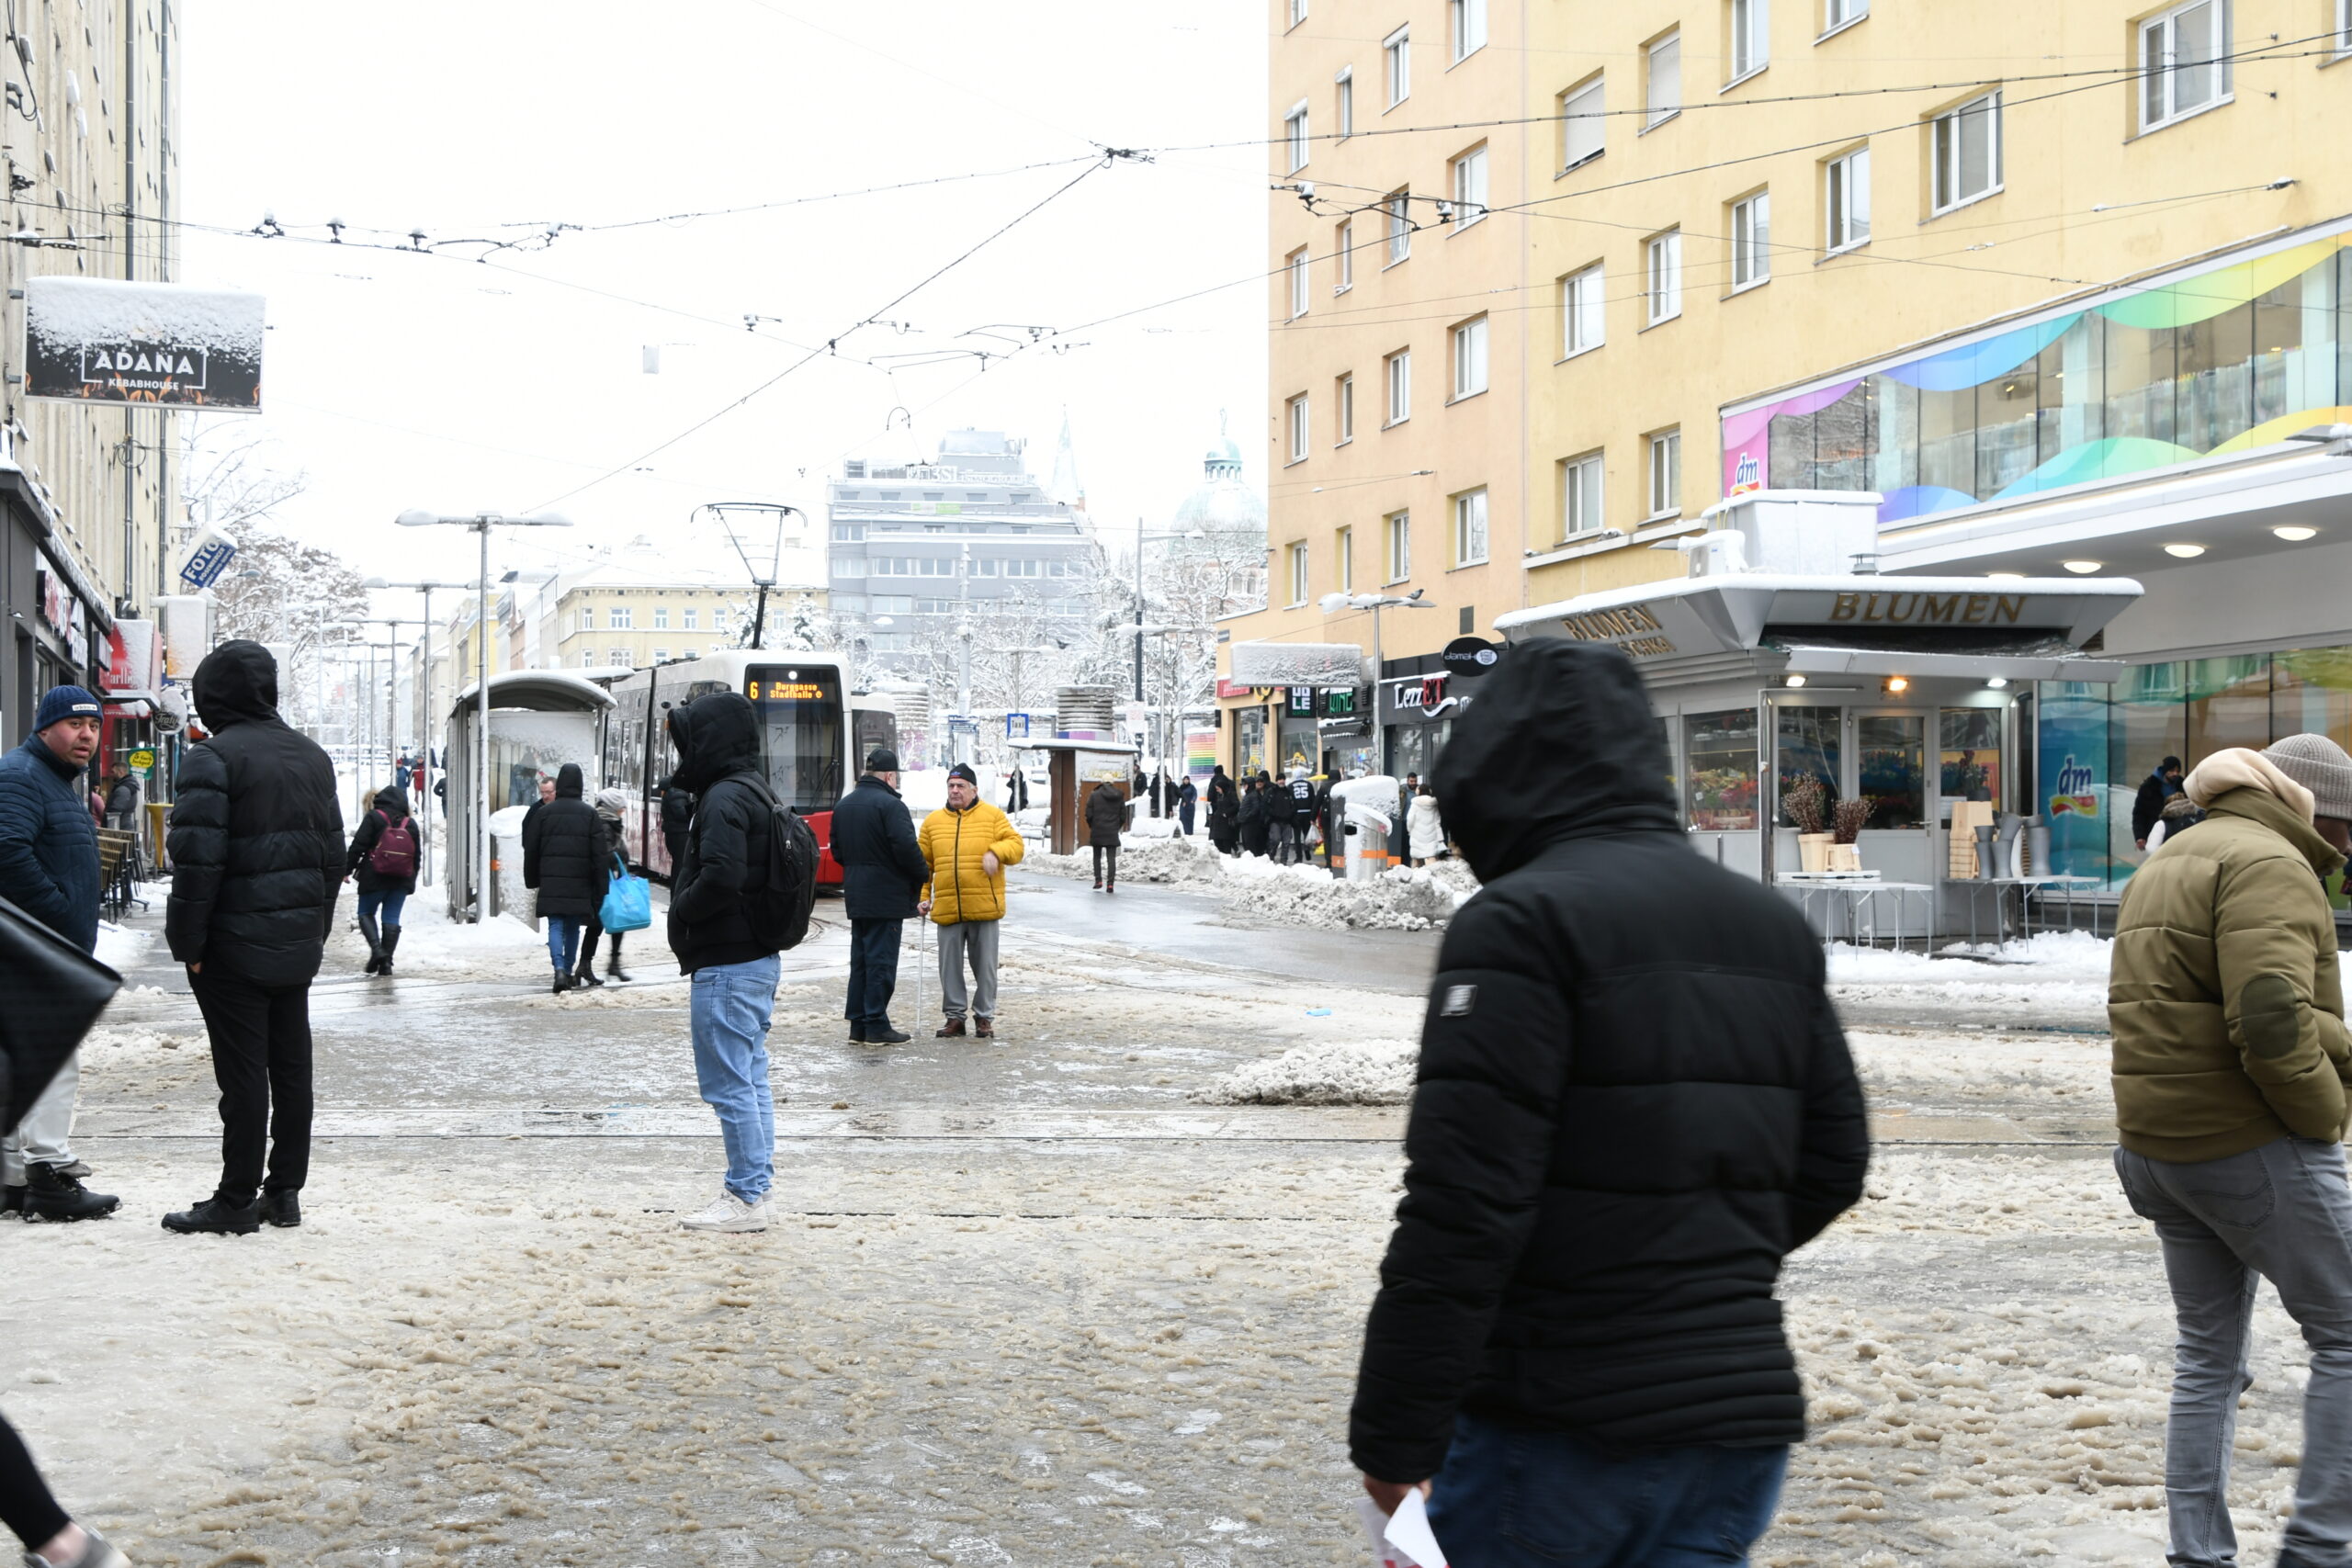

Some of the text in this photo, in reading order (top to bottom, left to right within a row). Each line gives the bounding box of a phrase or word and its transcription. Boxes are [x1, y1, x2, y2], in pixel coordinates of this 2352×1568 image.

[95, 352, 195, 375] ADANA
[107, 377, 180, 390] KEBABHOUSE
[1736, 455, 1758, 485] dm
[184, 536, 220, 581] FOTO
[1827, 592, 2027, 624] BLUMEN
[1561, 604, 1663, 641] BLUMEN
[750, 682, 759, 699] 6
[770, 690, 813, 699] Stadthalle
[775, 682, 818, 693] Burggasse
[1394, 678, 1444, 709] LezzET
[1292, 697, 1310, 710] LE
[2058, 757, 2092, 795] dm
[1294, 786, 1308, 799] 25
